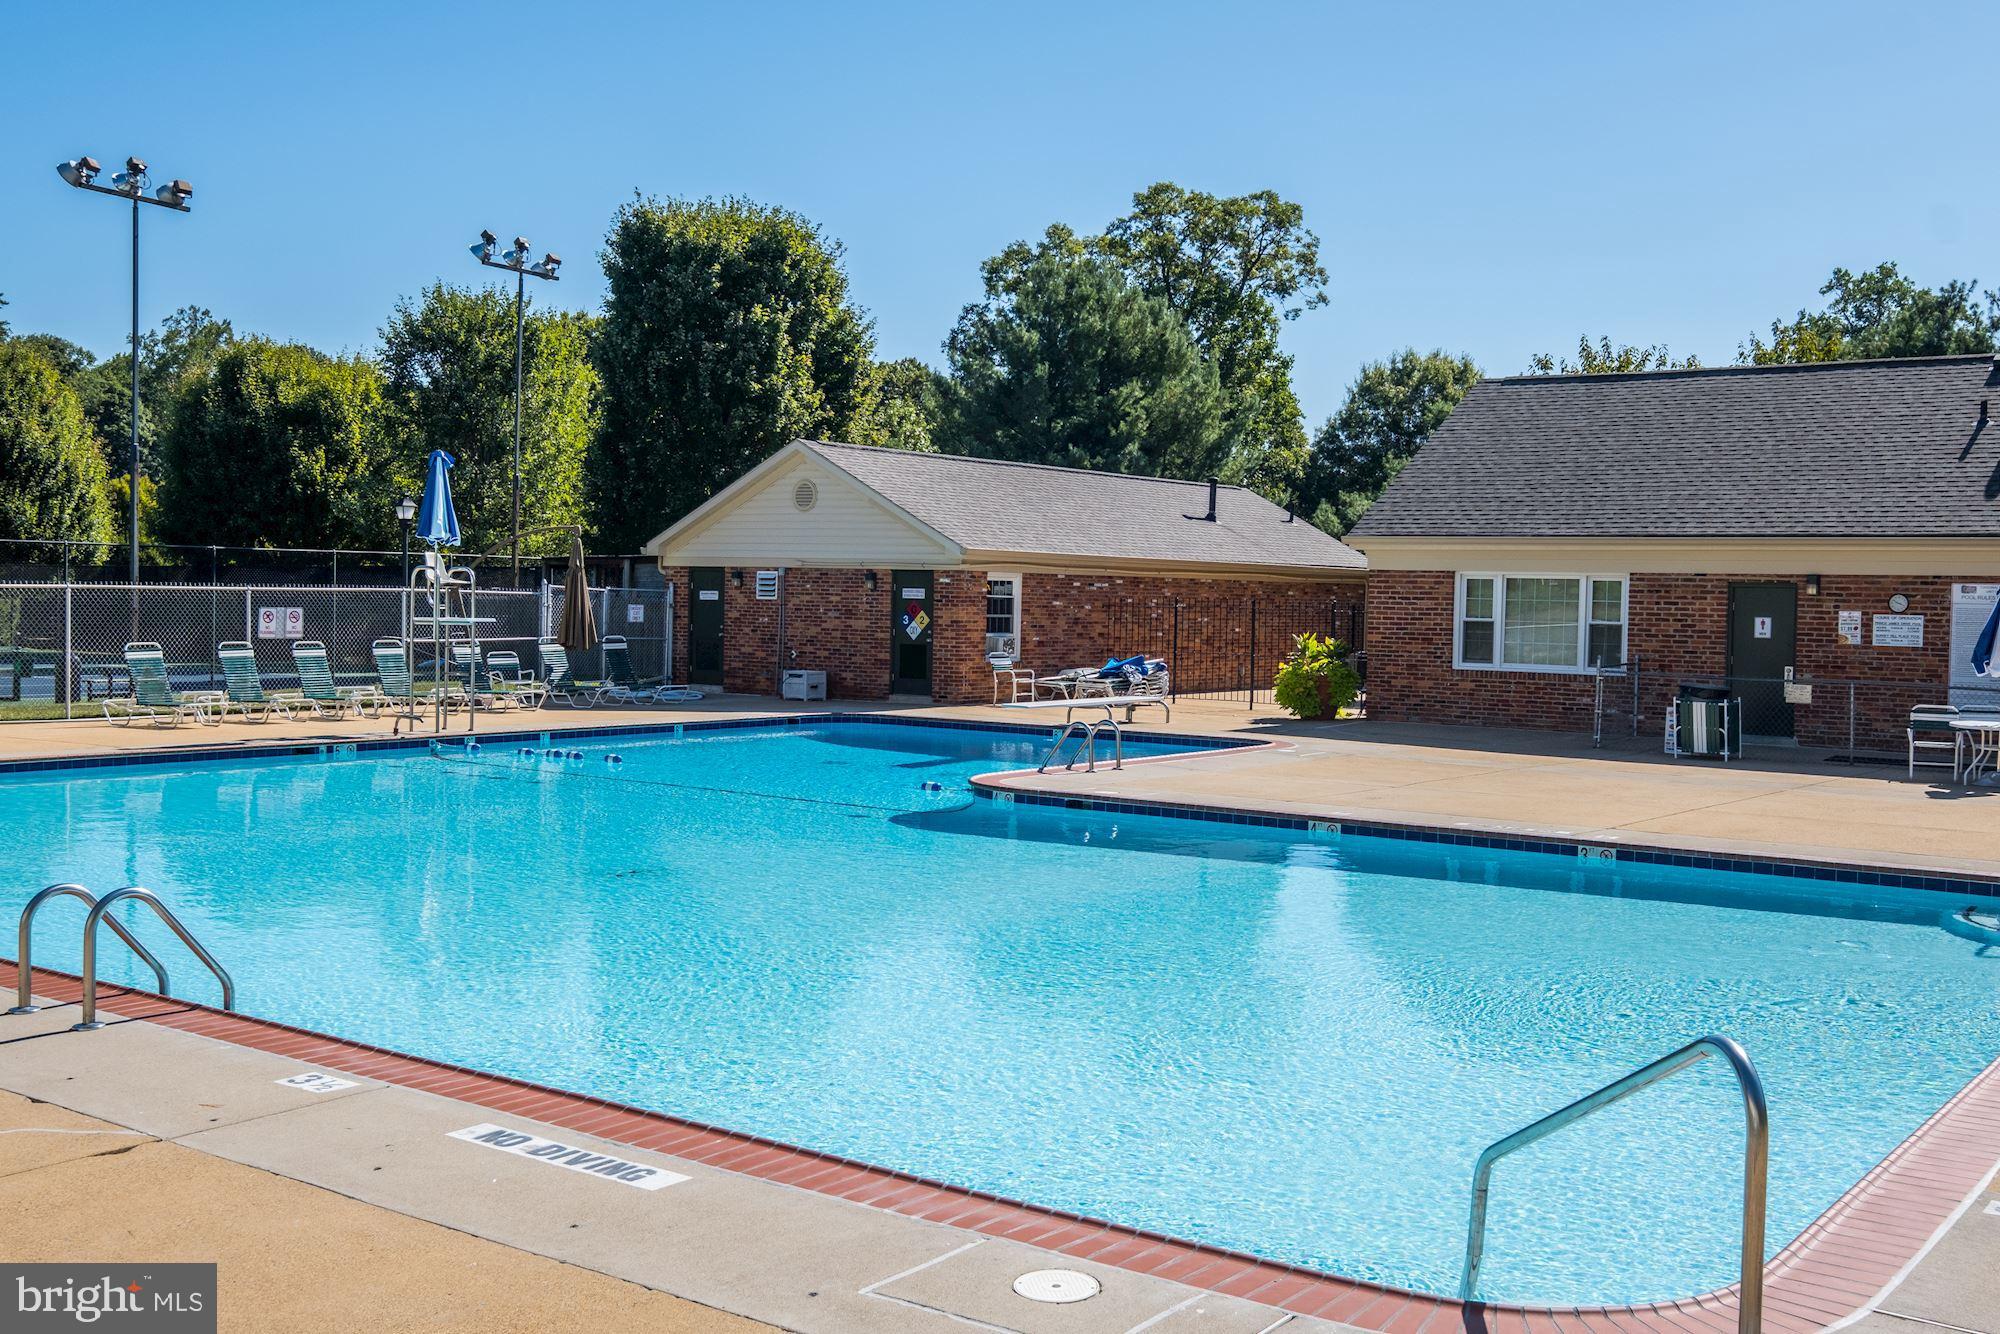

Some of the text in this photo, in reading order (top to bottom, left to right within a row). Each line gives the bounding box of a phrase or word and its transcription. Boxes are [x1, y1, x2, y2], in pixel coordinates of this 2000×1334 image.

[903, 615, 909, 624] 3
[919, 616, 925, 625] 2
[473, 1129, 657, 1182] NO DIVING
